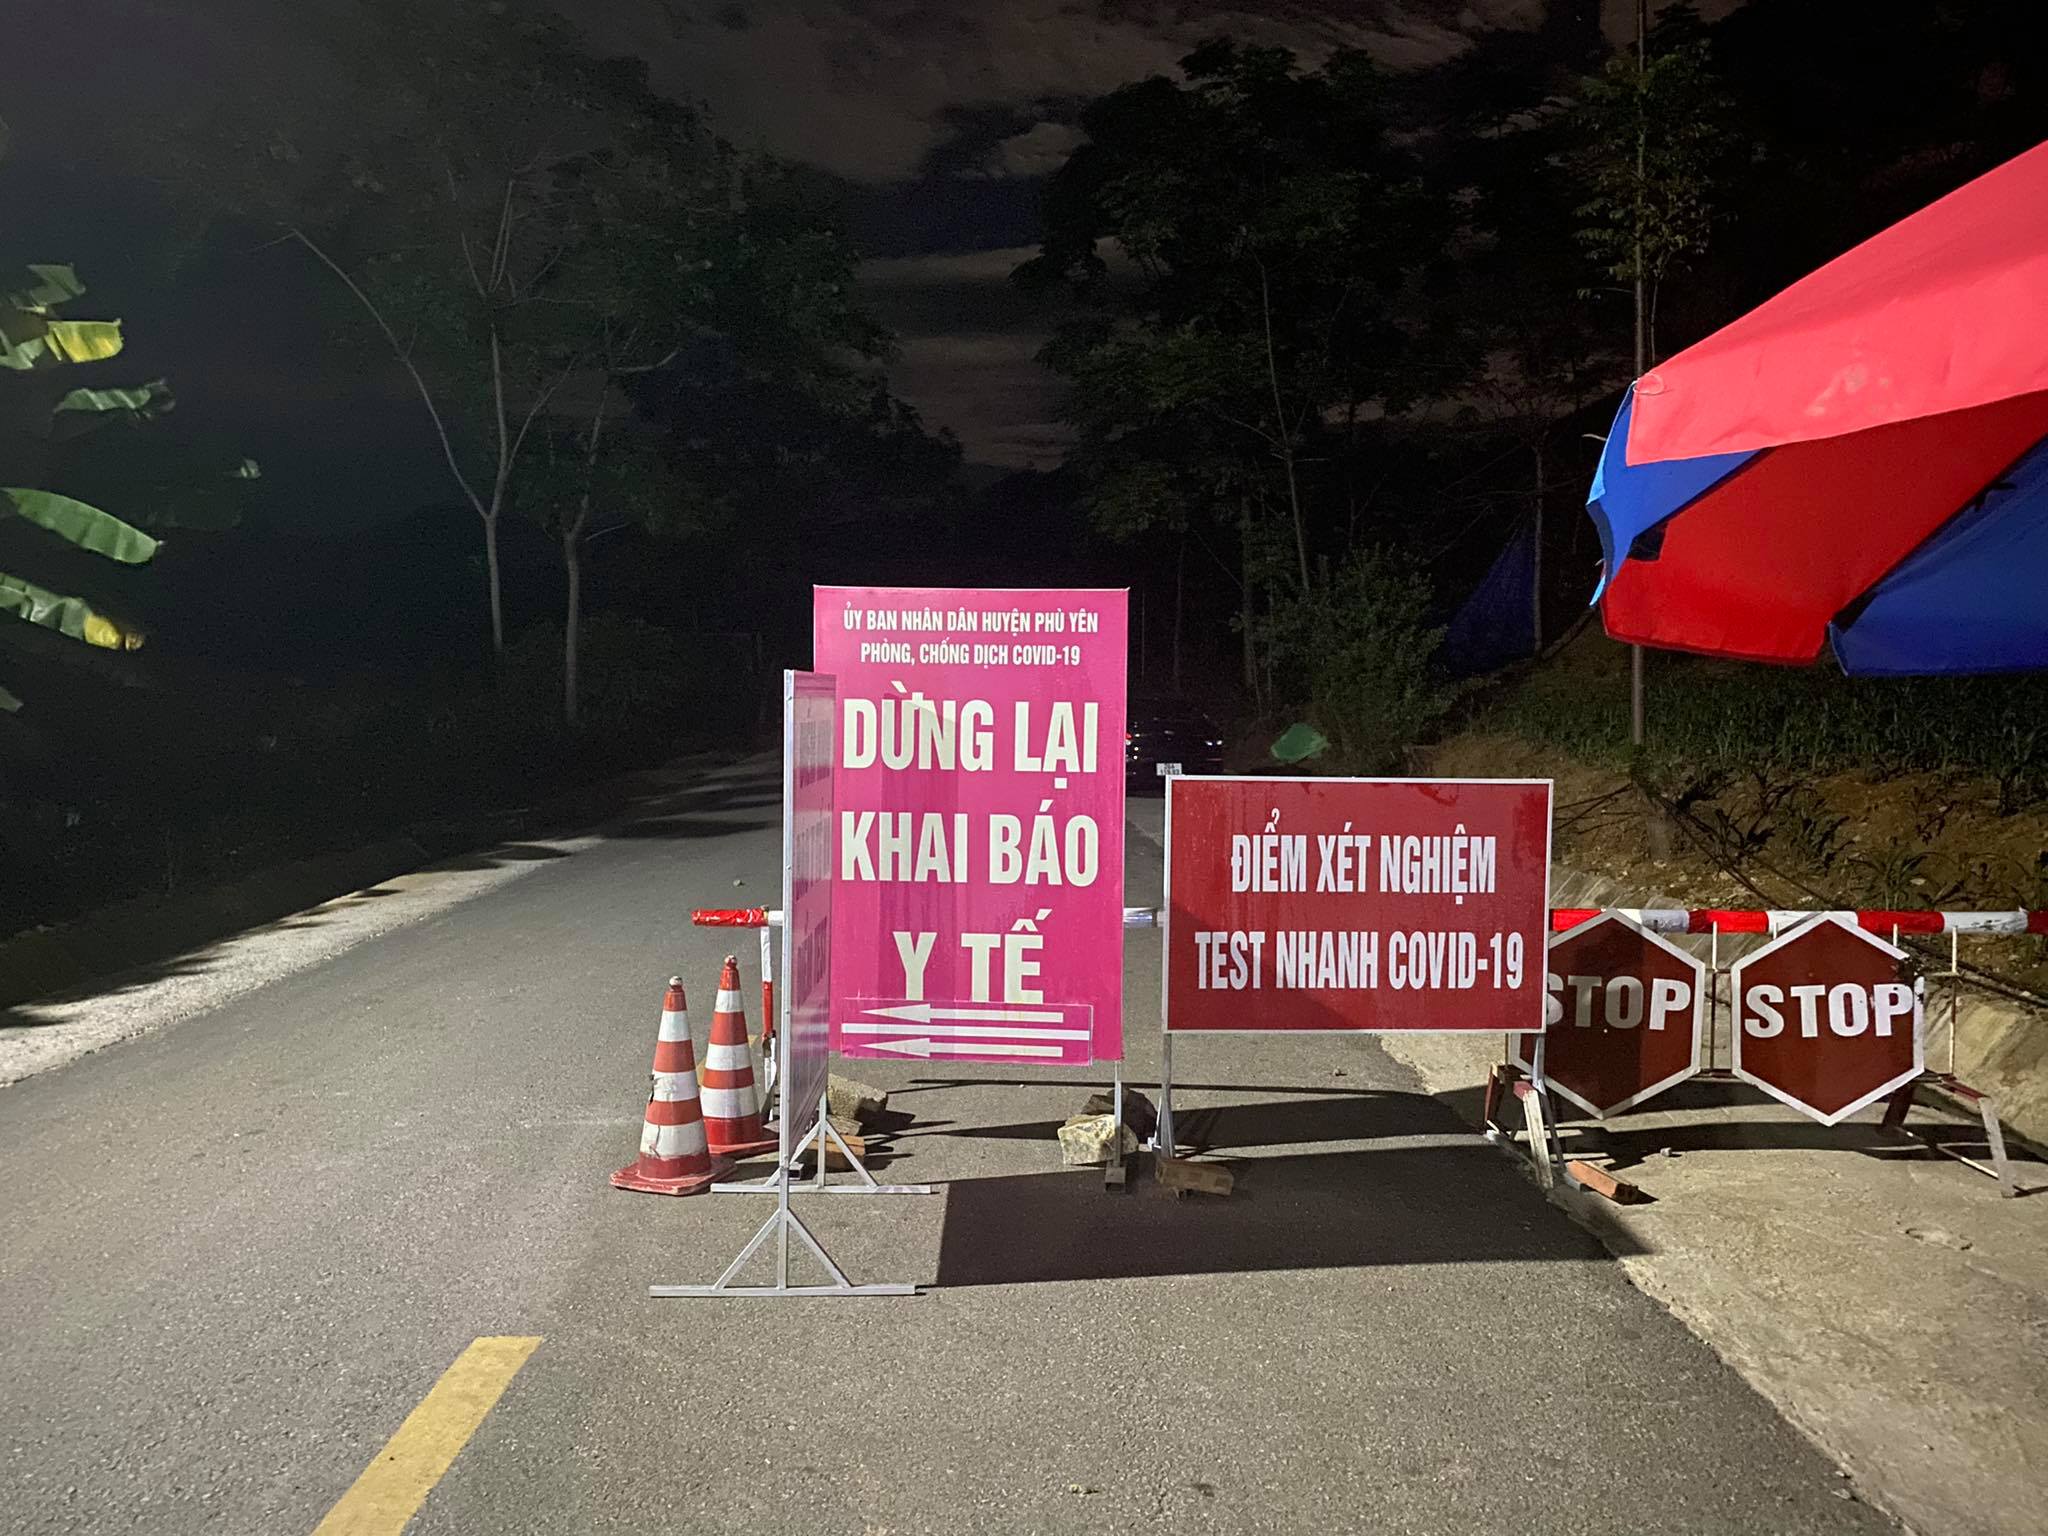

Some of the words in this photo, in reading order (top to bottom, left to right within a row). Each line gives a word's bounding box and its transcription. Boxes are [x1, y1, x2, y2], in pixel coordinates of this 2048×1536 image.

[843, 601, 862, 630] ỦY
[867, 610, 897, 631] BAN
[902, 606, 943, 631] NHÂN
[947, 606, 978, 632] DÂN
[982, 608, 1030, 637] HUYỆN
[1035, 608, 1064, 633] PHÙ
[1069, 608, 1098, 633] YÊN
[861, 638, 915, 666] PHÒNG,
[919, 637, 970, 664] CHỐNG
[974, 644, 1008, 669] DỊCH
[1013, 645, 1080, 665] COVID-19
[843, 680, 994, 772] DỪNG
[1014, 701, 1099, 790] LẠI
[841, 811, 968, 884] KHAI
[989, 799, 1099, 887] BÁO
[1231, 808, 1307, 893] ĐIỂM
[1316, 822, 1371, 893] XÉT
[1379, 824, 1496, 904] NGHIỆM
[893, 931, 937, 1001] Y
[961, 908, 1052, 1004] TẾ
[1195, 931, 1265, 989] TEST
[1276, 931, 1378, 989] NHANH
[1388, 931, 1524, 990] COVID-19
[1744, 982, 1913, 1038] STOP
